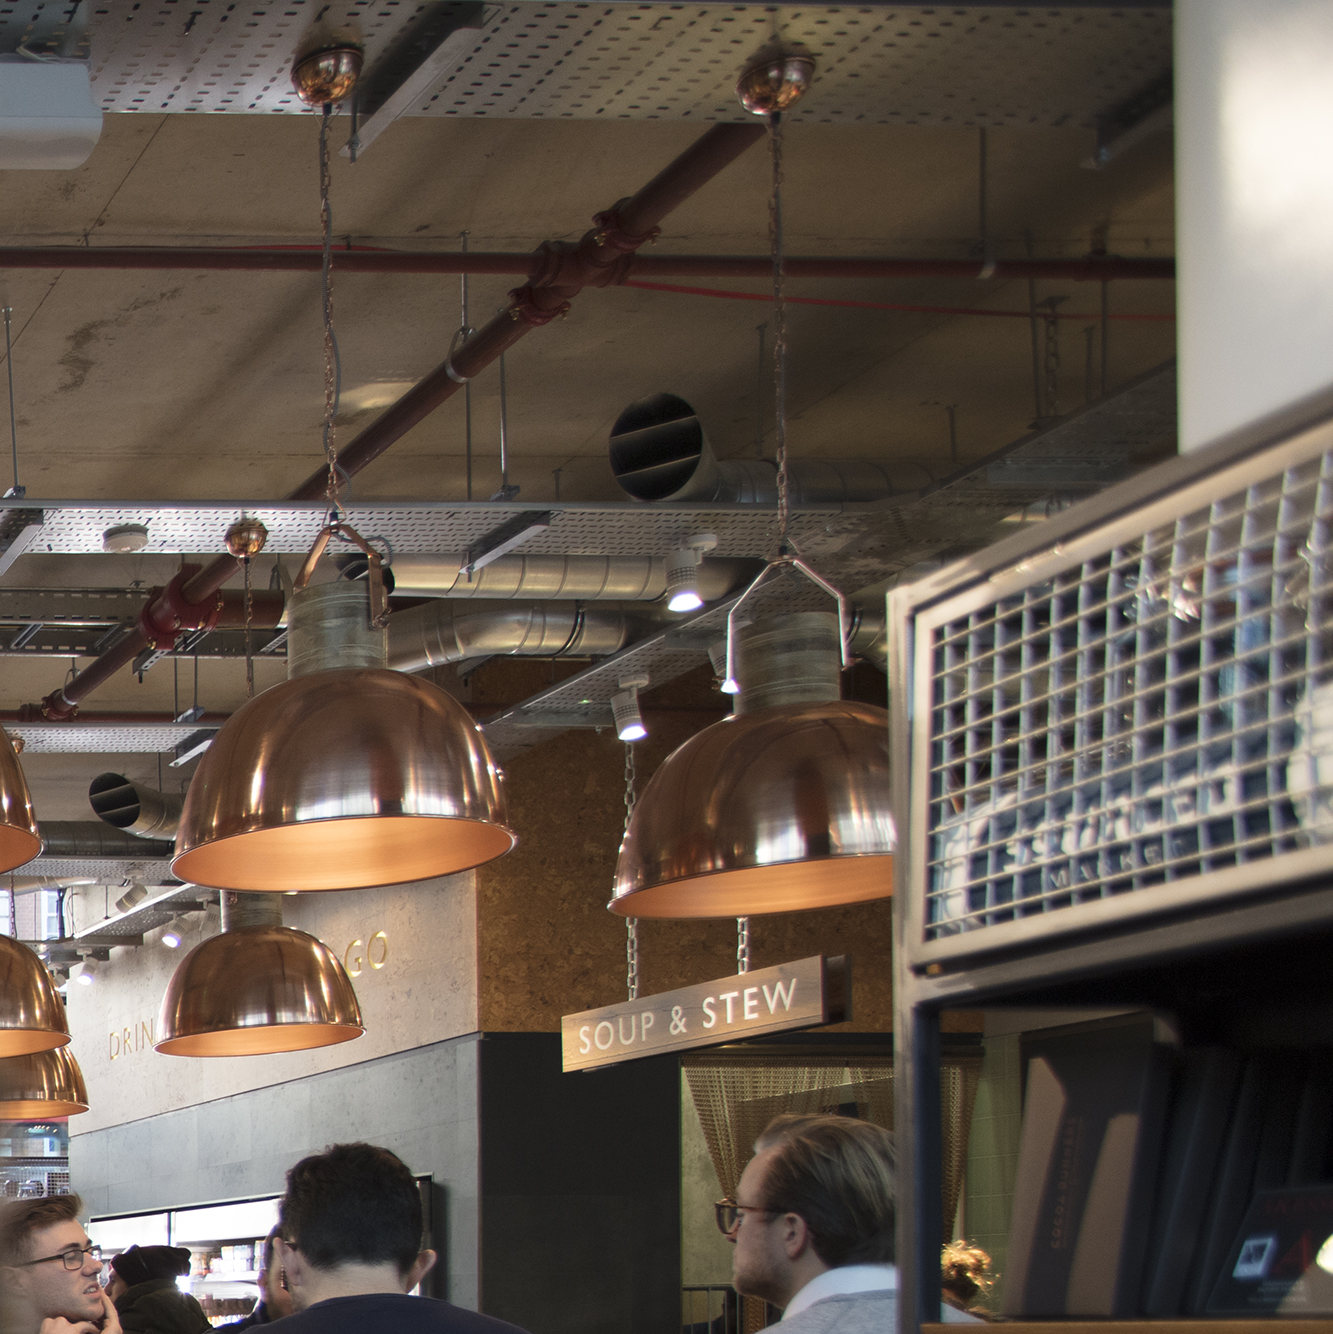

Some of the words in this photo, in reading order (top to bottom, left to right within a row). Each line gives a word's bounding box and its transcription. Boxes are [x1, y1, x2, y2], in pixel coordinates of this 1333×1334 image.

[109, 1017, 154, 1061] DRIN
[579, 1011, 654, 1054] SOUP
[669, 1005, 687, 1036] &
[702, 977, 797, 1029] STEW
